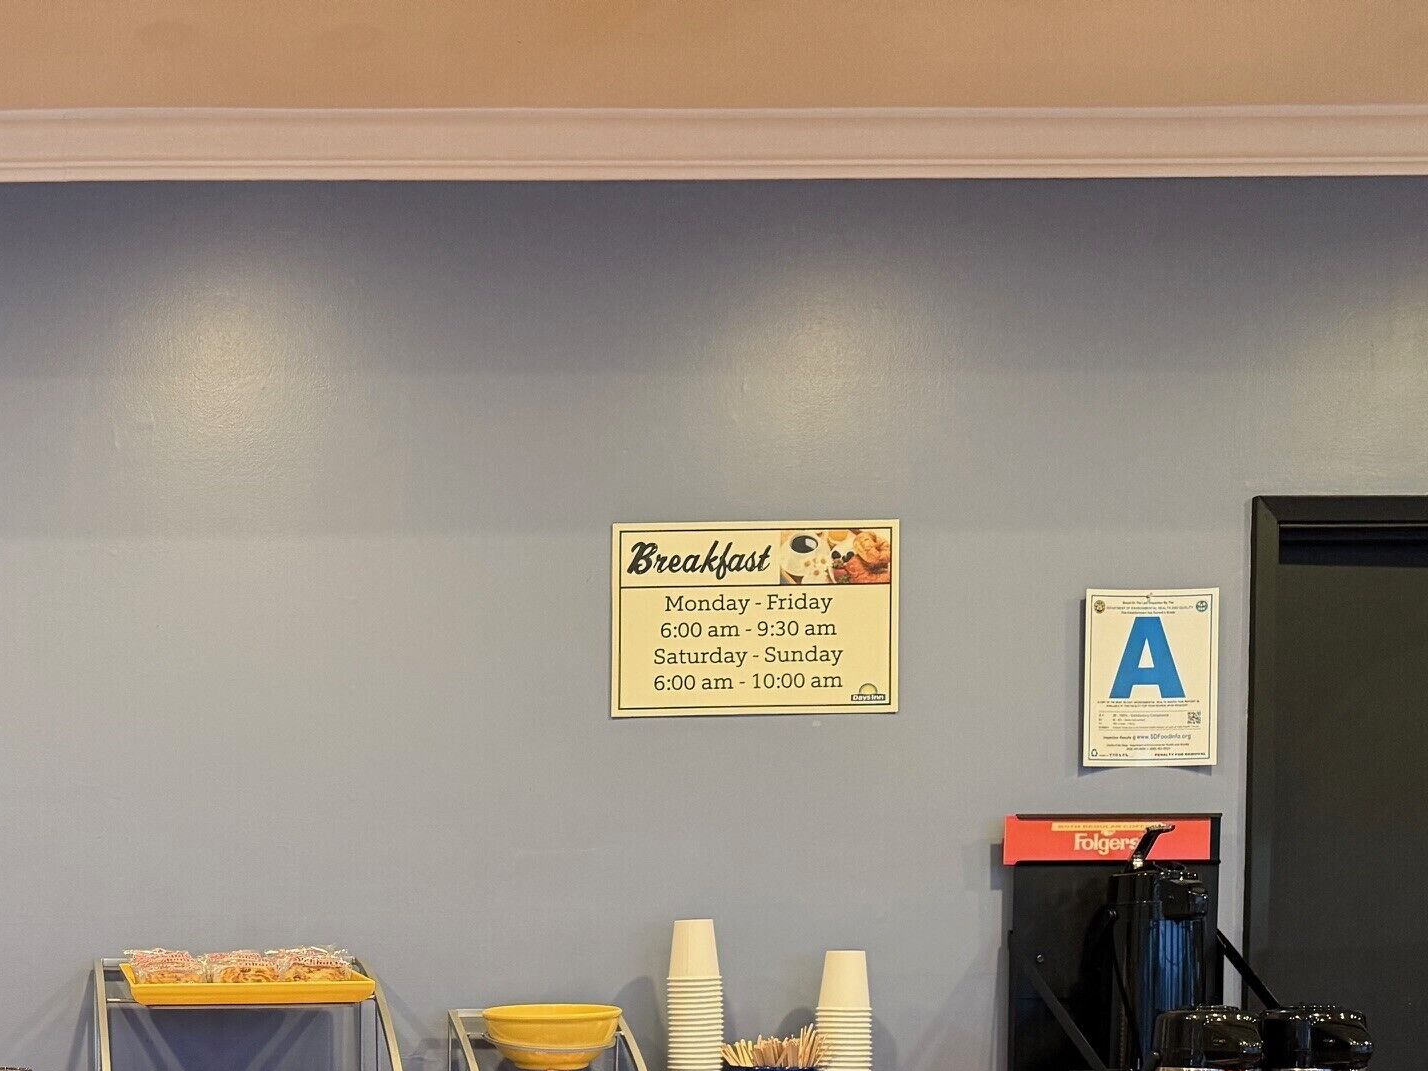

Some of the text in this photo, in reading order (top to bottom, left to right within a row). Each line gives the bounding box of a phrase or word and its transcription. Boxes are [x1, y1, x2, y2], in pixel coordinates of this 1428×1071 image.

[627, 540, 772, 580] Breakfast
[664, 594, 750, 615] Monday
[766, 593, 833, 614] Friday
[660, 622, 702, 638] 6:00
[707, 626, 740, 637] am
[757, 621, 799, 636] 9:30
[805, 624, 837, 636] am
[653, 647, 748, 668] Saturday
[764, 645, 843, 667] Sunday
[1109, 616, 1186, 698] A
[653, 675, 696, 691] 6:00
[701, 678, 734, 690] am
[752, 673, 806, 689] 10:00
[810, 676, 843, 688] am
[1074, 833, 1137, 855] Folgers
